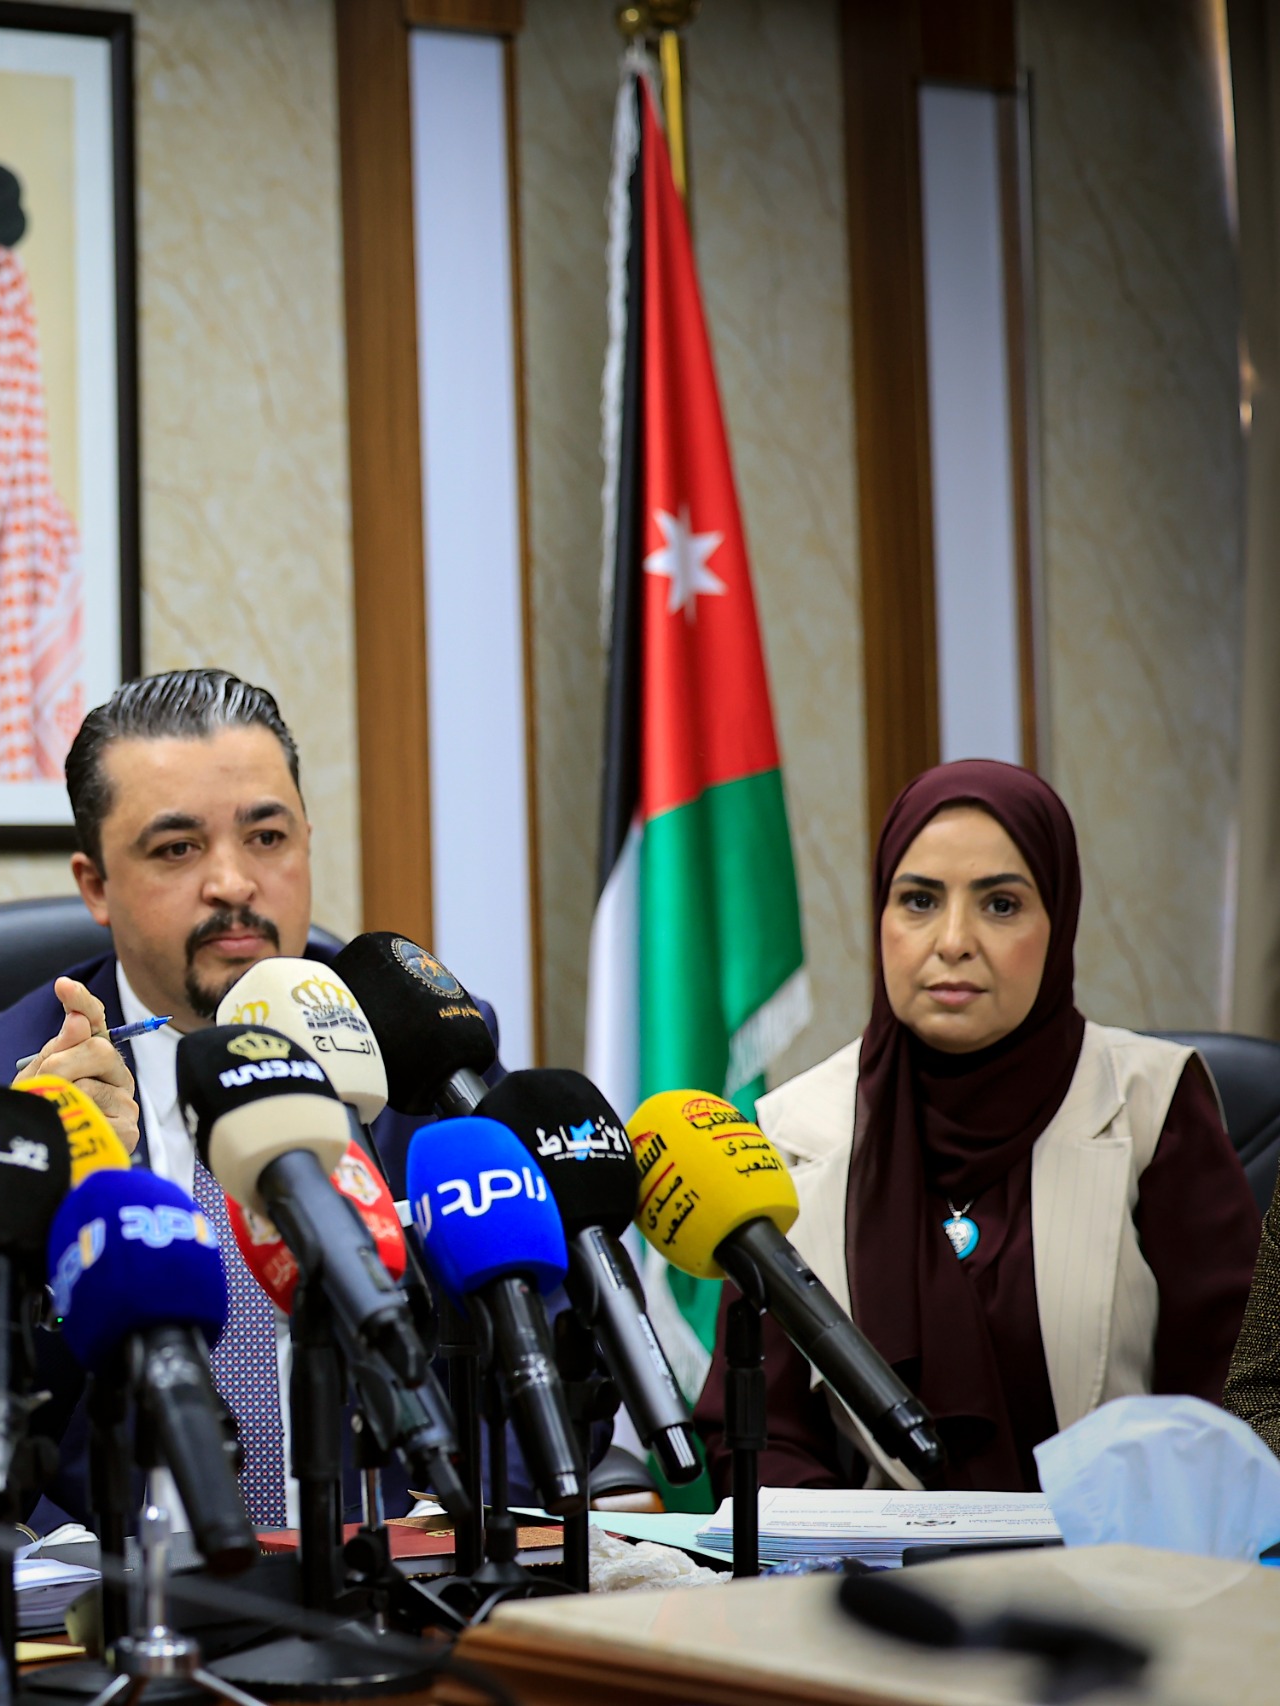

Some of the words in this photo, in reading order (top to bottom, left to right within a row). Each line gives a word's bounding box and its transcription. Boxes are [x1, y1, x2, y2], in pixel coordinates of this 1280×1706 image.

[312, 1034, 376, 1056] التاج
[535, 1114, 632, 1157] الأنباط
[721, 1139, 771, 1157] صدى
[735, 1155, 784, 1178] الشعب
[436, 1165, 548, 1217] راصد
[646, 1175, 684, 1231] صدى
[662, 1189, 701, 1246] الشعب
